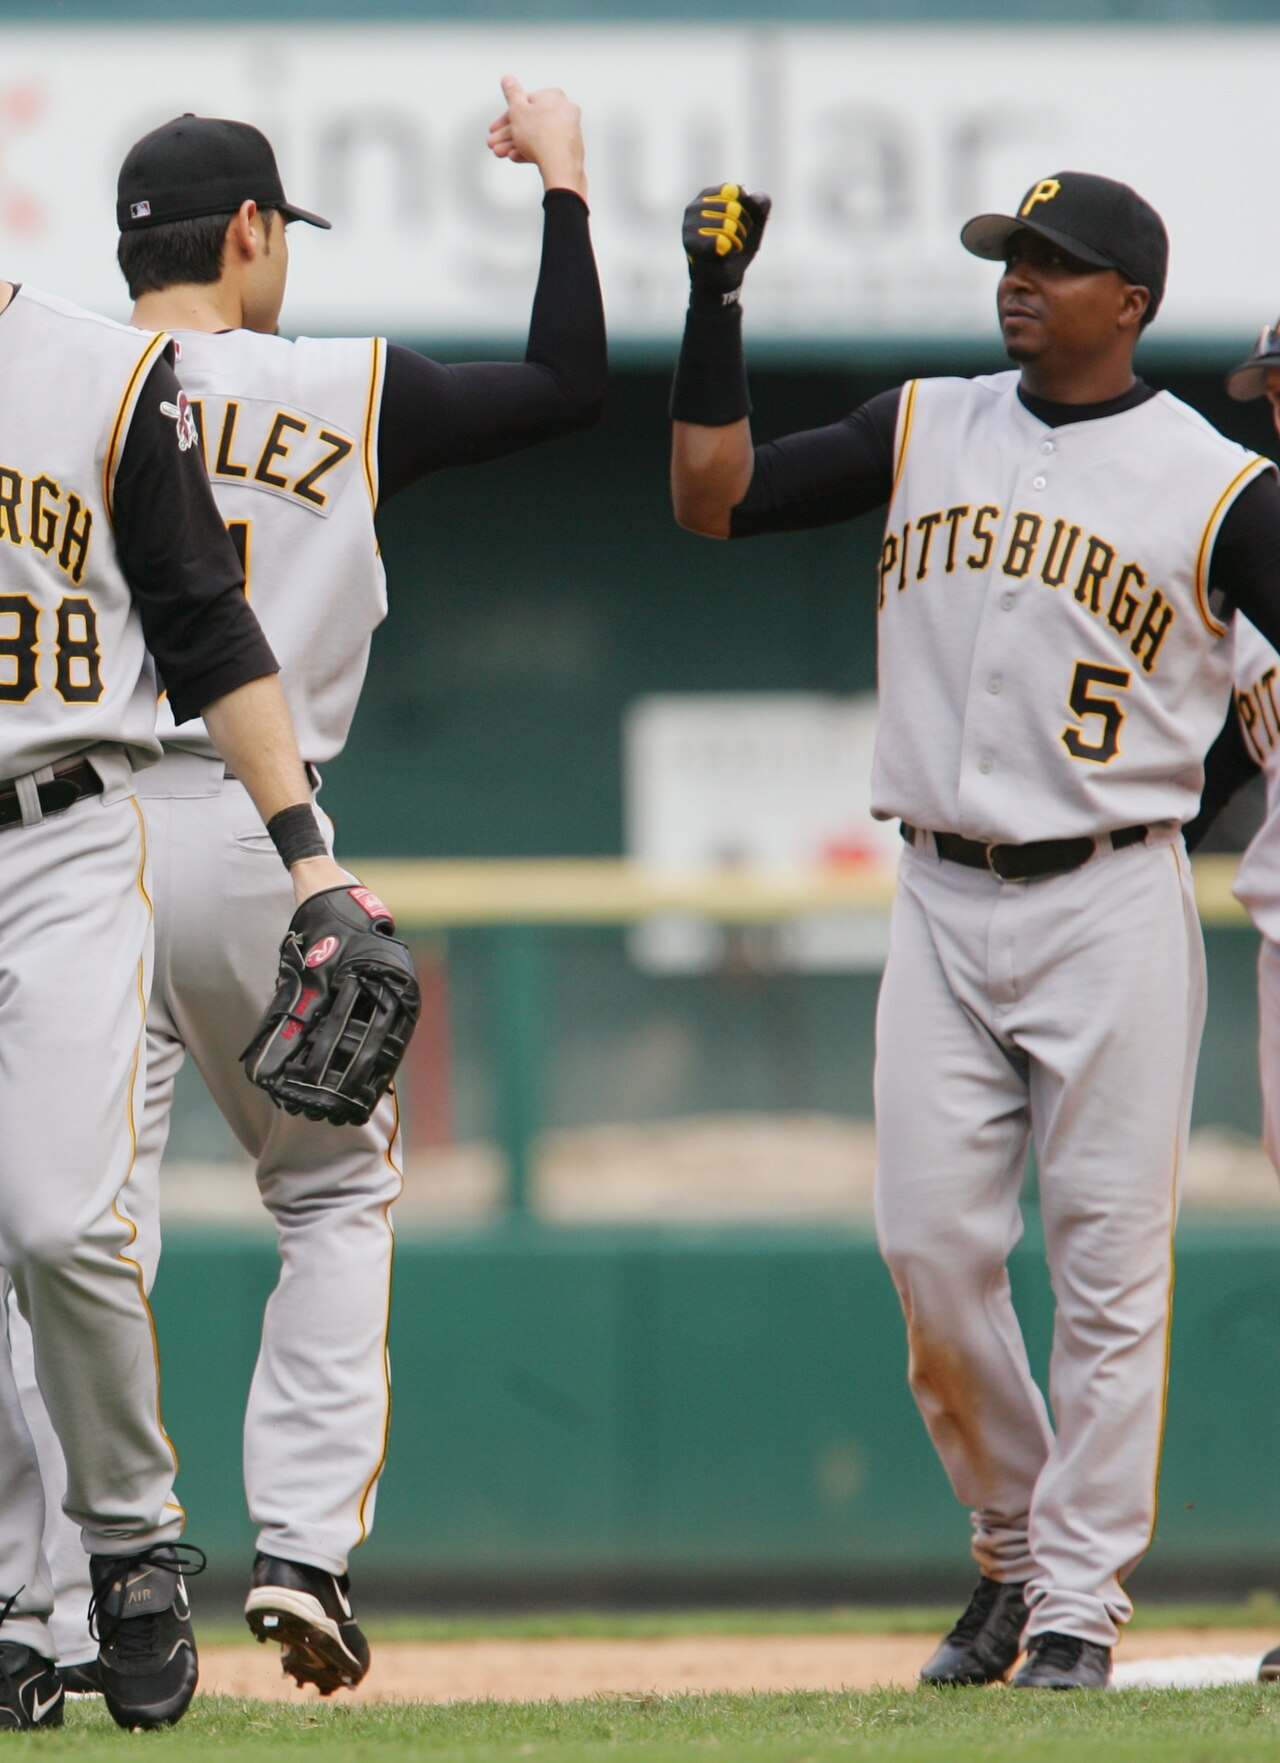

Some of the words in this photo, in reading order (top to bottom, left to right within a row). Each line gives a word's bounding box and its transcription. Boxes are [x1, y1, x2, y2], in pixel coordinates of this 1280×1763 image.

[1020, 178, 1062, 218] P
[877, 504, 1176, 676] PITTSBURGH
[1060, 659, 1132, 765] 5
[128, 1588, 151, 1605] AIR
